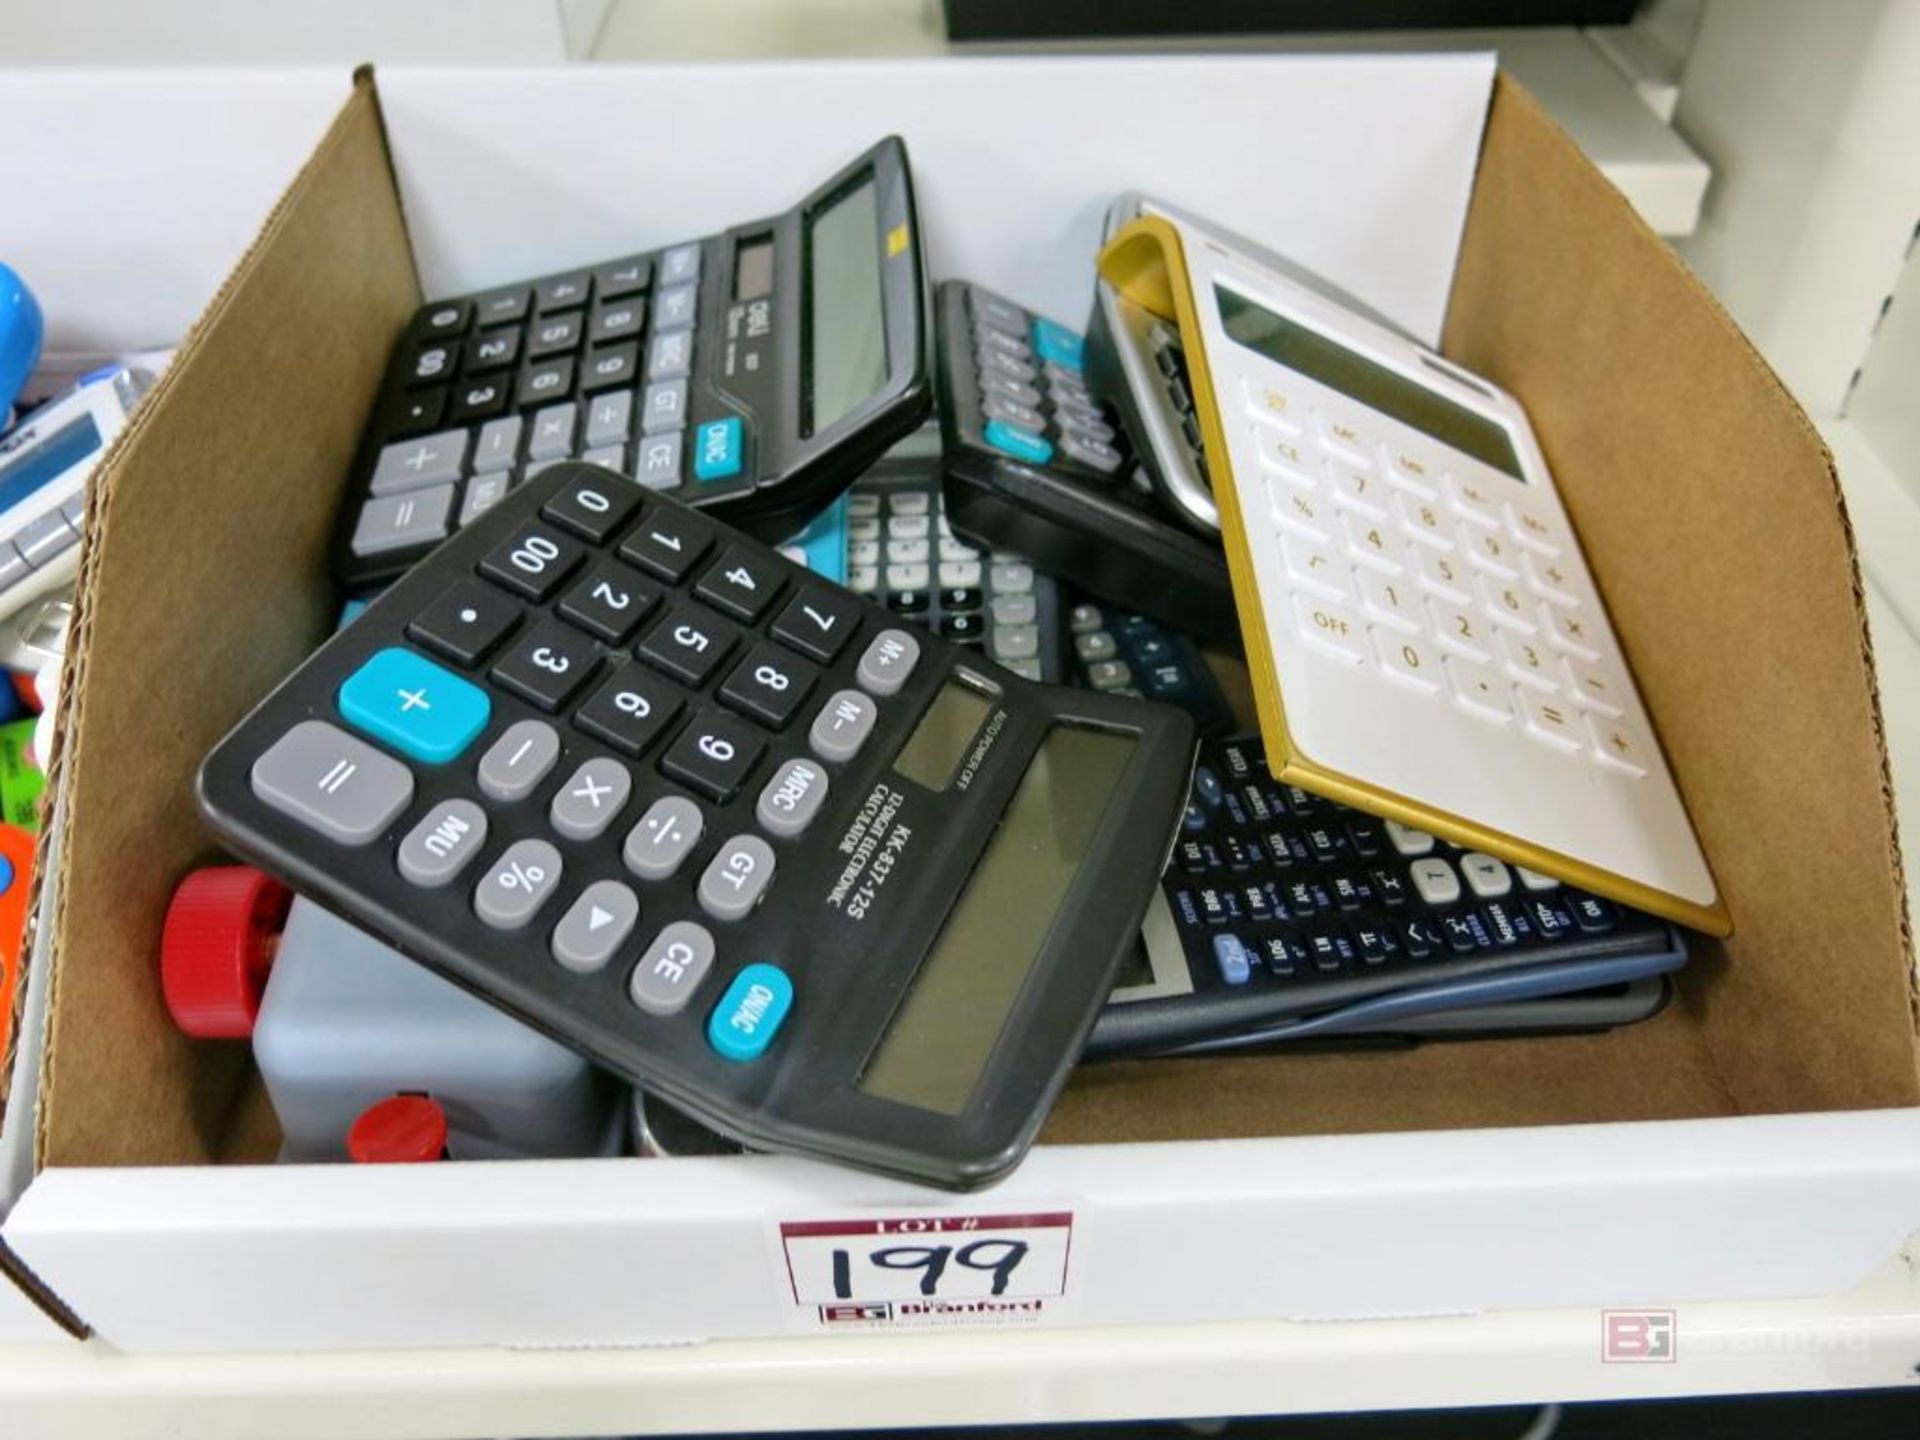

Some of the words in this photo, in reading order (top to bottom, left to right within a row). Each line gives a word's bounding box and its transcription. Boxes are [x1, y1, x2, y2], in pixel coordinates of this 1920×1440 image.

[614, 267, 639, 282] 7
[553, 284, 577, 298] 4
[431, 306, 459, 327] 0
[603, 309, 632, 329] 8
[542, 324, 570, 344] 5
[479, 340, 506, 359] 2
[415, 348, 447, 377] 00
[596, 357, 624, 376] 9
[532, 371, 560, 391] 6
[468, 386, 495, 406] 3
[648, 443, 673, 470] CE
[1353, 476, 1366, 494] 7
[576, 489, 610, 513] 0
[650, 530, 682, 553] 1
[1367, 529, 1383, 550] 4
[510, 536, 559, 574] 00
[724, 566, 757, 591] 4
[1438, 560, 1454, 581] 5
[592, 582, 630, 609] 2
[1385, 587, 1398, 607] 1
[1503, 590, 1520, 611] 6
[802, 604, 837, 632] 7
[1313, 610, 1351, 637] OFF
[1456, 615, 1474, 638] 2
[673, 624, 710, 653] 5
[531, 646, 570, 675] 3
[878, 639, 905, 667] M+
[1402, 645, 1420, 668] 0
[1522, 645, 1540, 668] 3
[754, 664, 790, 693] 8
[614, 690, 651, 719] 6
[832, 699, 862, 731] M-
[698, 733, 735, 762] 9
[772, 764, 816, 812] MRC
[838, 783, 890, 855] CALCULATOR
[424, 814, 471, 858] MU
[720, 851, 756, 891] GT
[827, 834, 881, 908] ELECTRONIC
[847, 823, 912, 920] KK-837-12S
[1426, 871, 1445, 881] 7
[1267, 938, 1288, 960] LOG
[653, 941, 694, 984] CE
[877, 1218, 949, 1233] LOT
[832, 1238, 1029, 1300] 199
